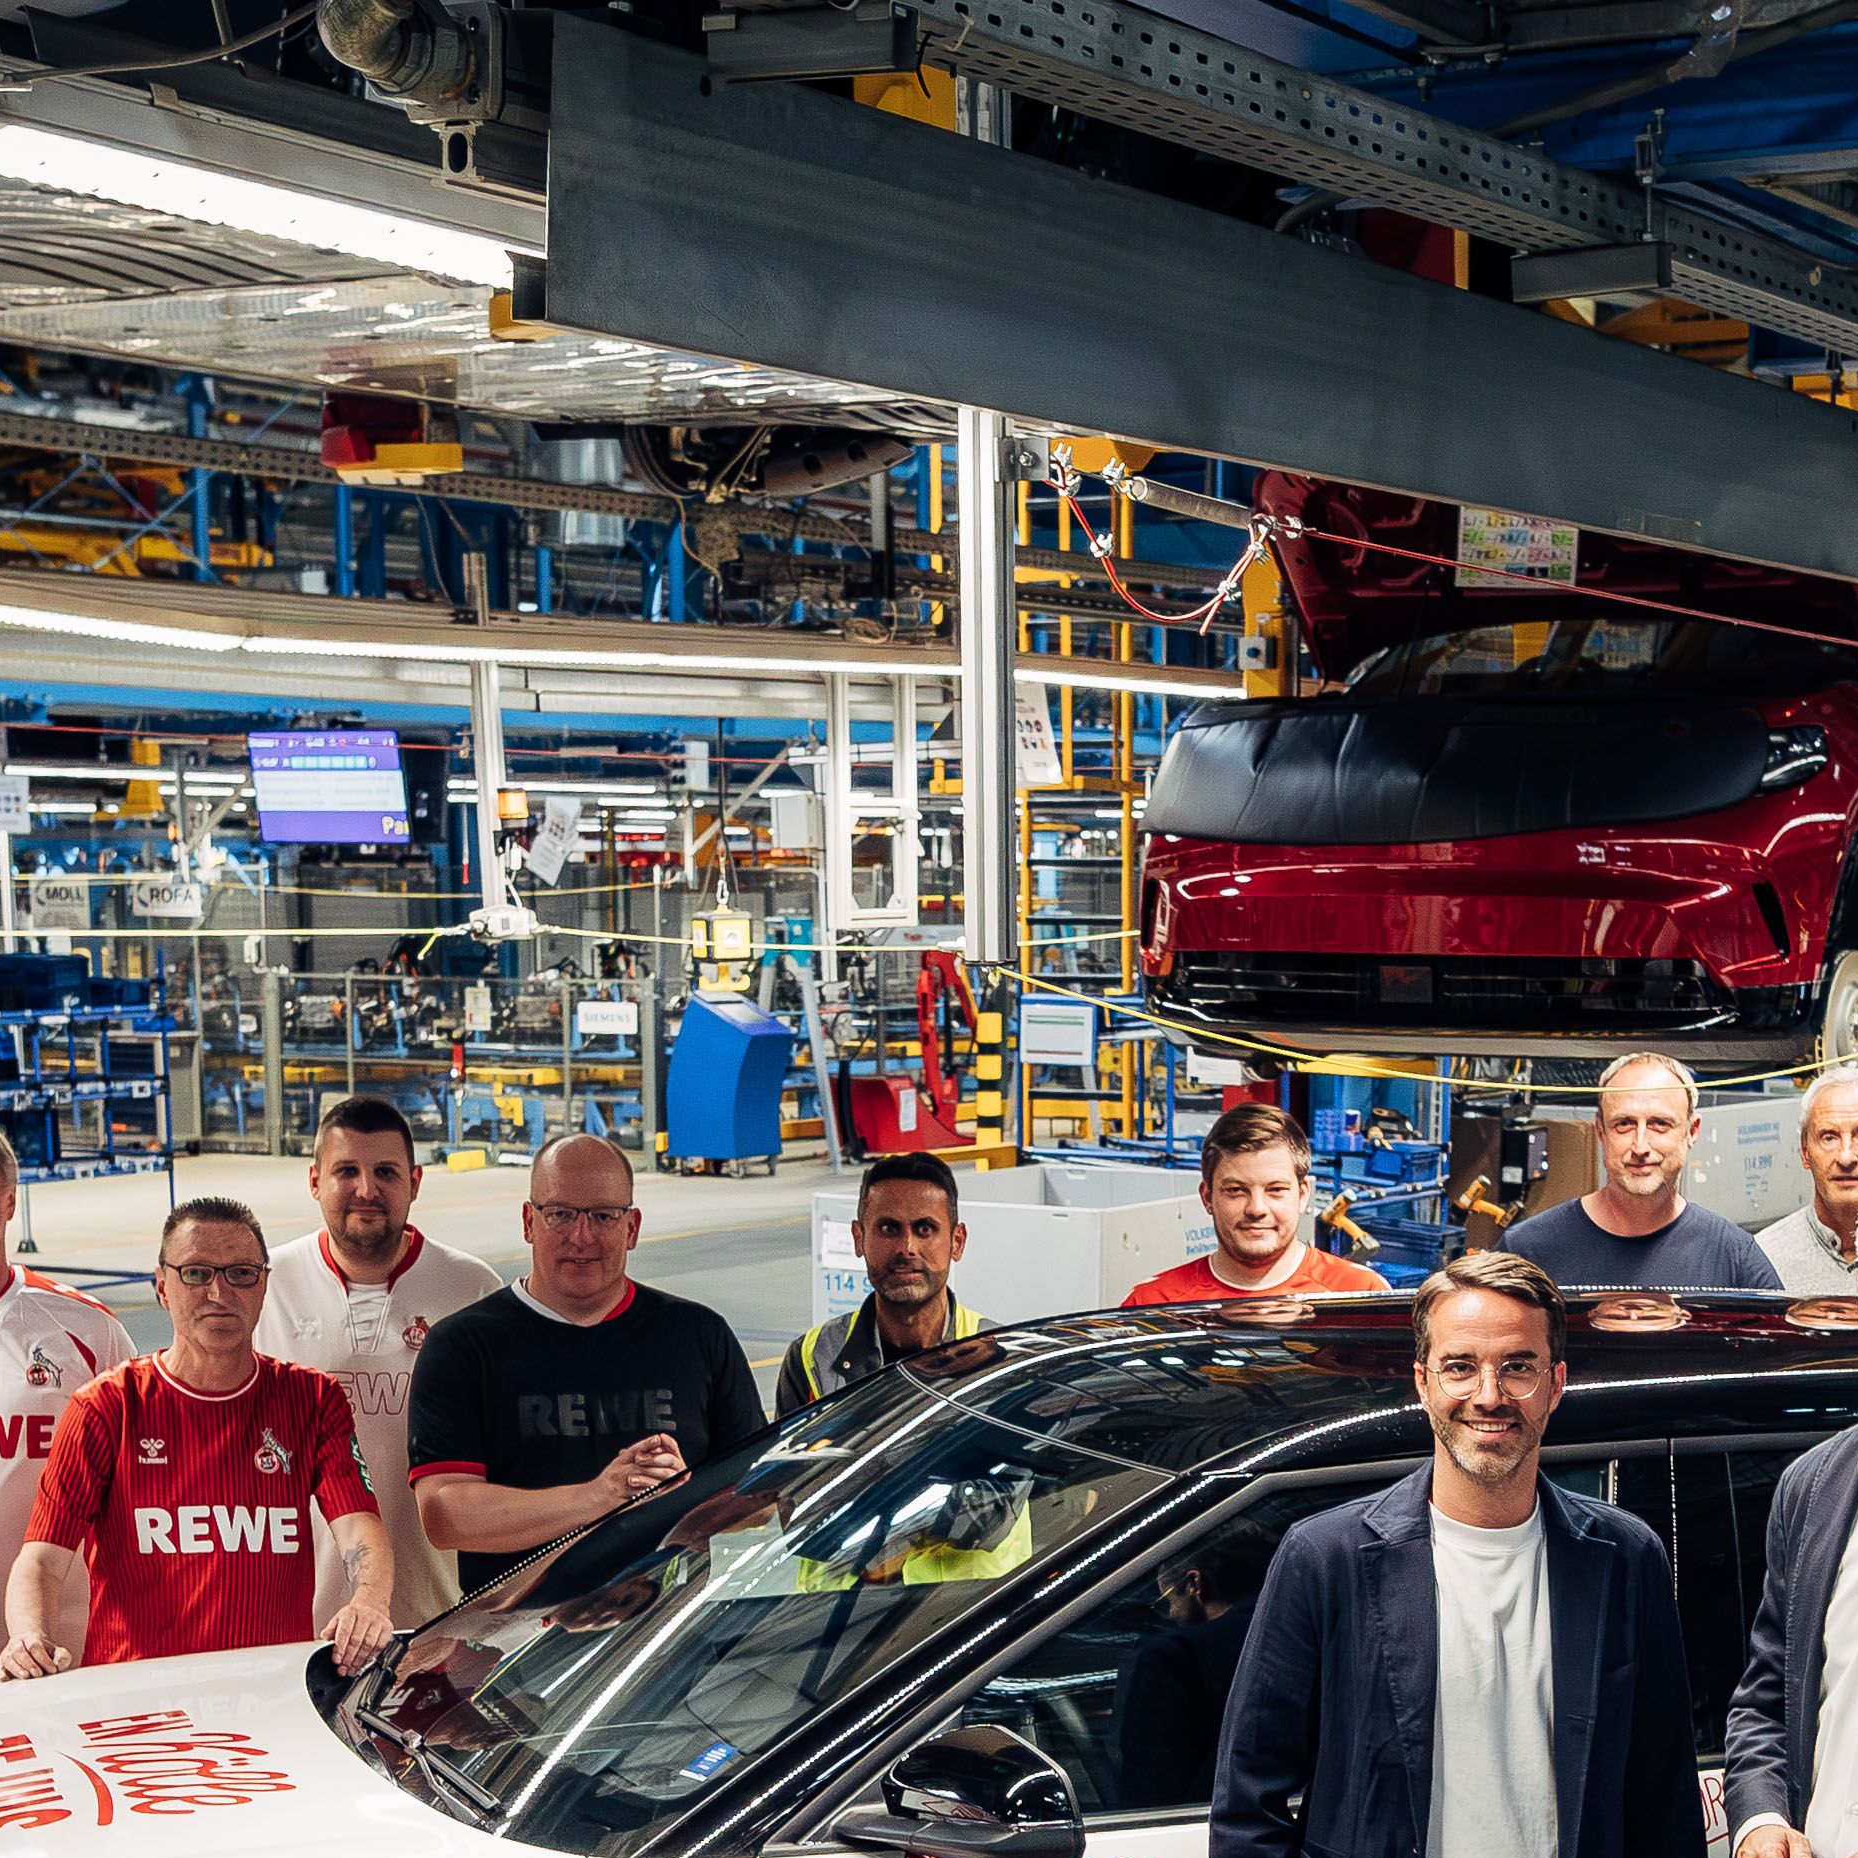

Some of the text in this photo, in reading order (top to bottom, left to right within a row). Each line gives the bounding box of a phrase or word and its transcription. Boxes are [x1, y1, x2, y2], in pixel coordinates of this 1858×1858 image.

[824, 1274, 855, 1291] 114
[518, 1389, 677, 1436] REWE
[134, 1505, 299, 1554] REWE
[77, 1710, 297, 1815] EN Kölle
